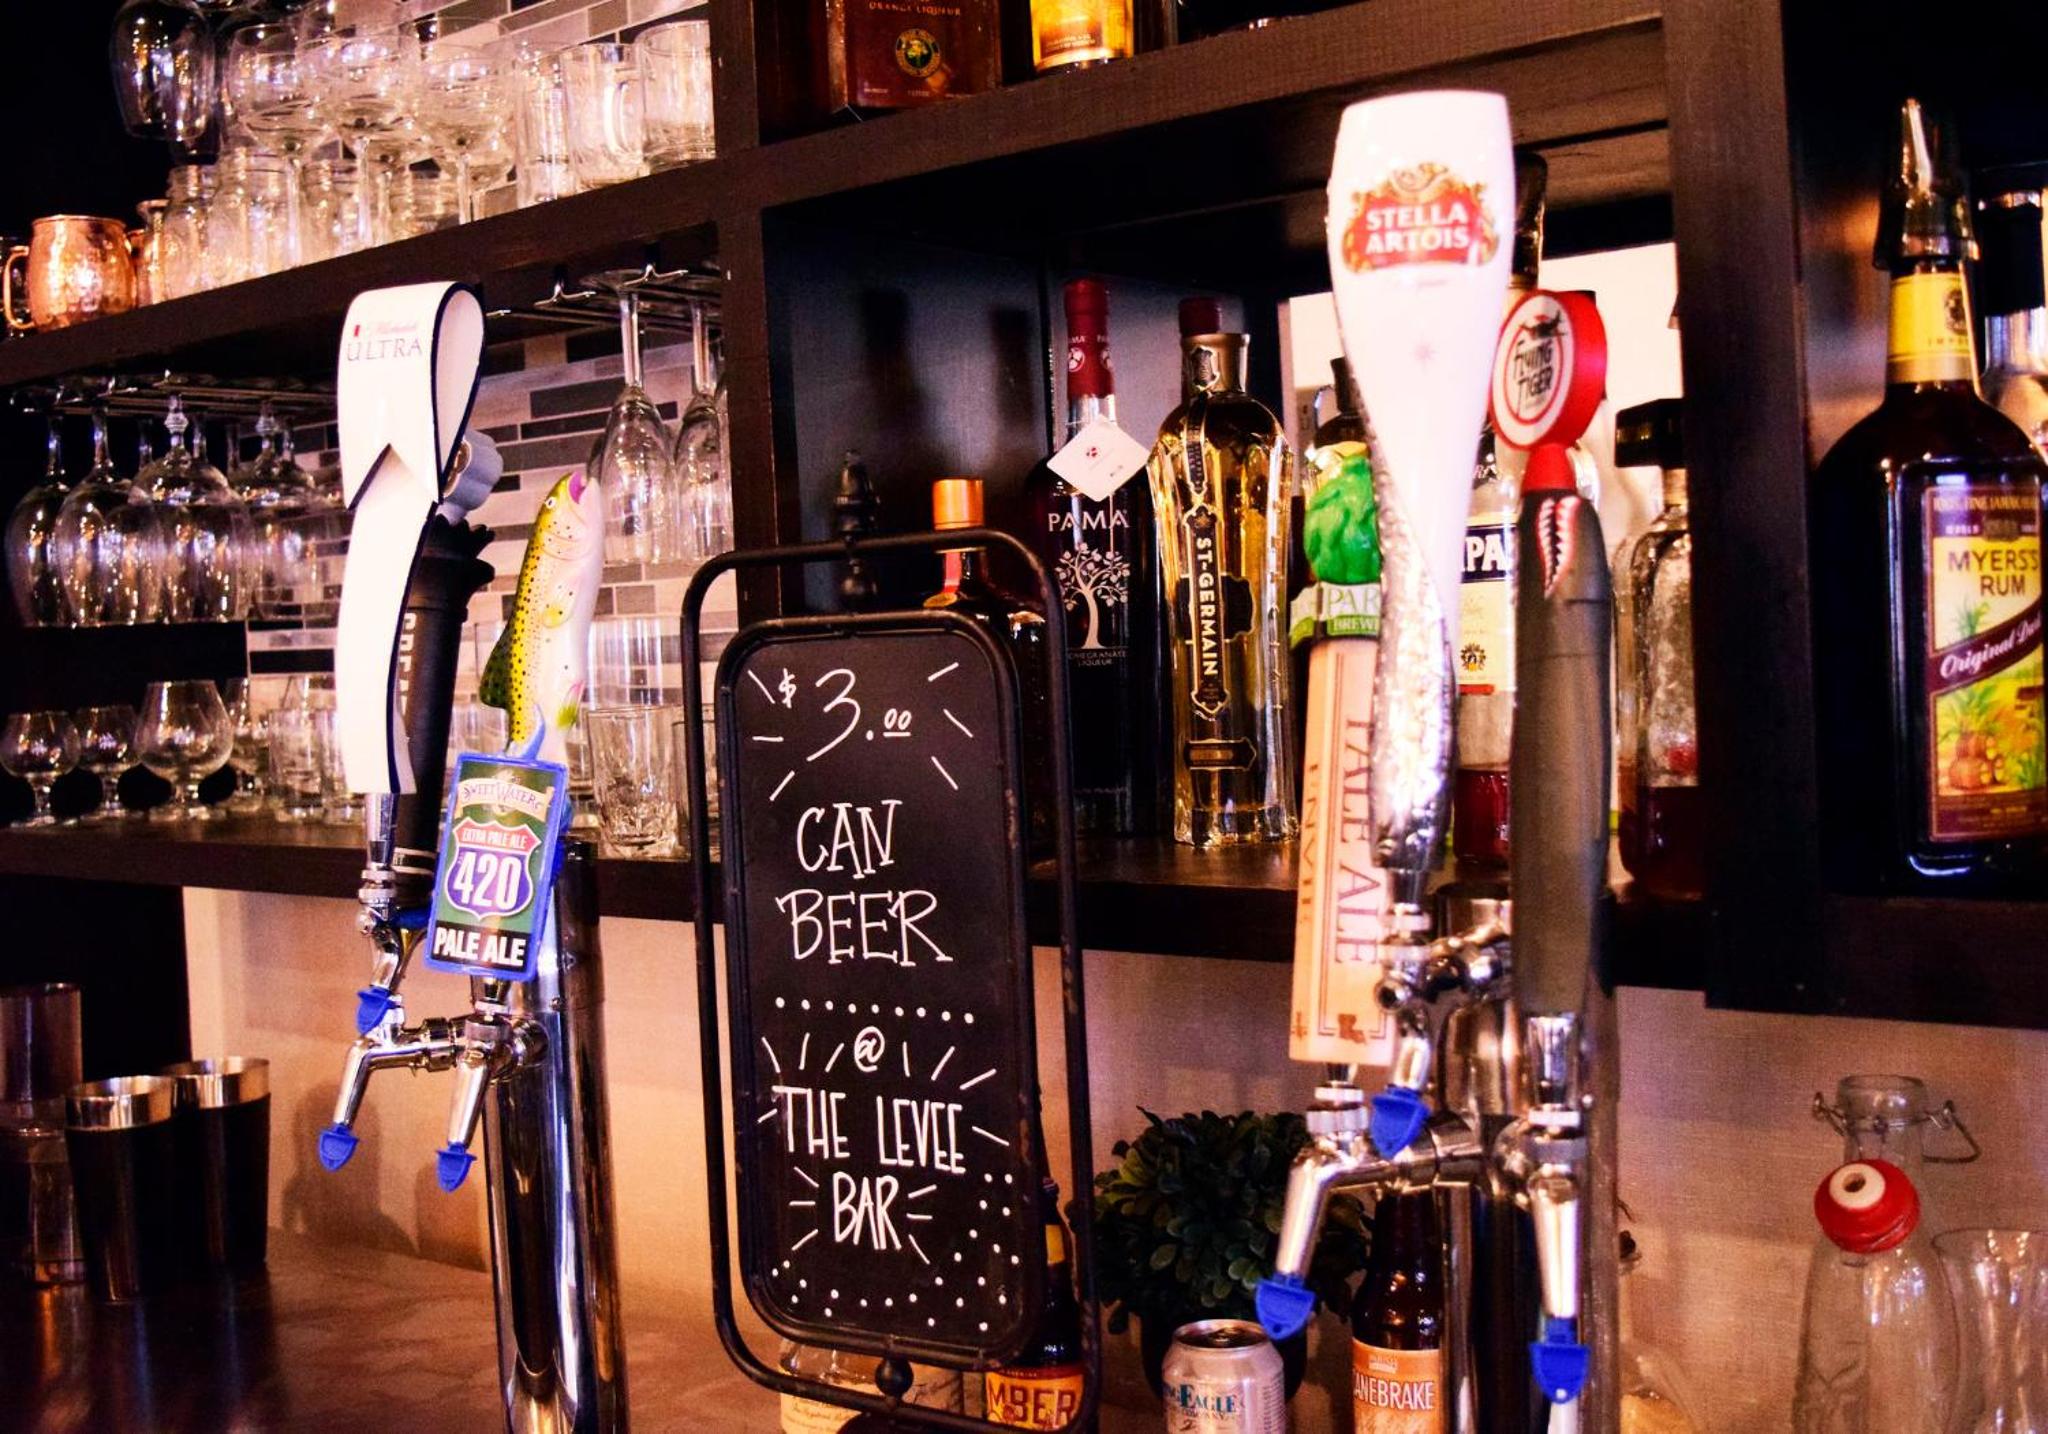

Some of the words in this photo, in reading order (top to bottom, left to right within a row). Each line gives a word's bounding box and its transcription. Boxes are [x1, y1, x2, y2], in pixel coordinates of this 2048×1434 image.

[1364, 226, 1470, 255] ARTOIS
[1365, 201, 1469, 231] STELLA
[347, 337, 423, 361] ULTRA
[1048, 510, 1129, 532] PAMA
[1196, 537, 1218, 676] ST-GERMAIN
[1980, 575, 2026, 597] RUM
[1940, 628, 2015, 679] Original
[510, 832, 529, 849] ALE
[796, 799, 904, 880] CAN
[452, 851, 522, 911] 420
[774, 888, 954, 968] BEER
[1335, 863, 1380, 965] ALE
[433, 926, 479, 960] PALE
[482, 936, 526, 967] ALE
[853, 1025, 887, 1074] @
[771, 1083, 850, 1160] THE
[875, 1094, 967, 1174] LEVEE
[831, 1170, 903, 1251] BAR
[1179, 1384, 1238, 1413] EAGLE
